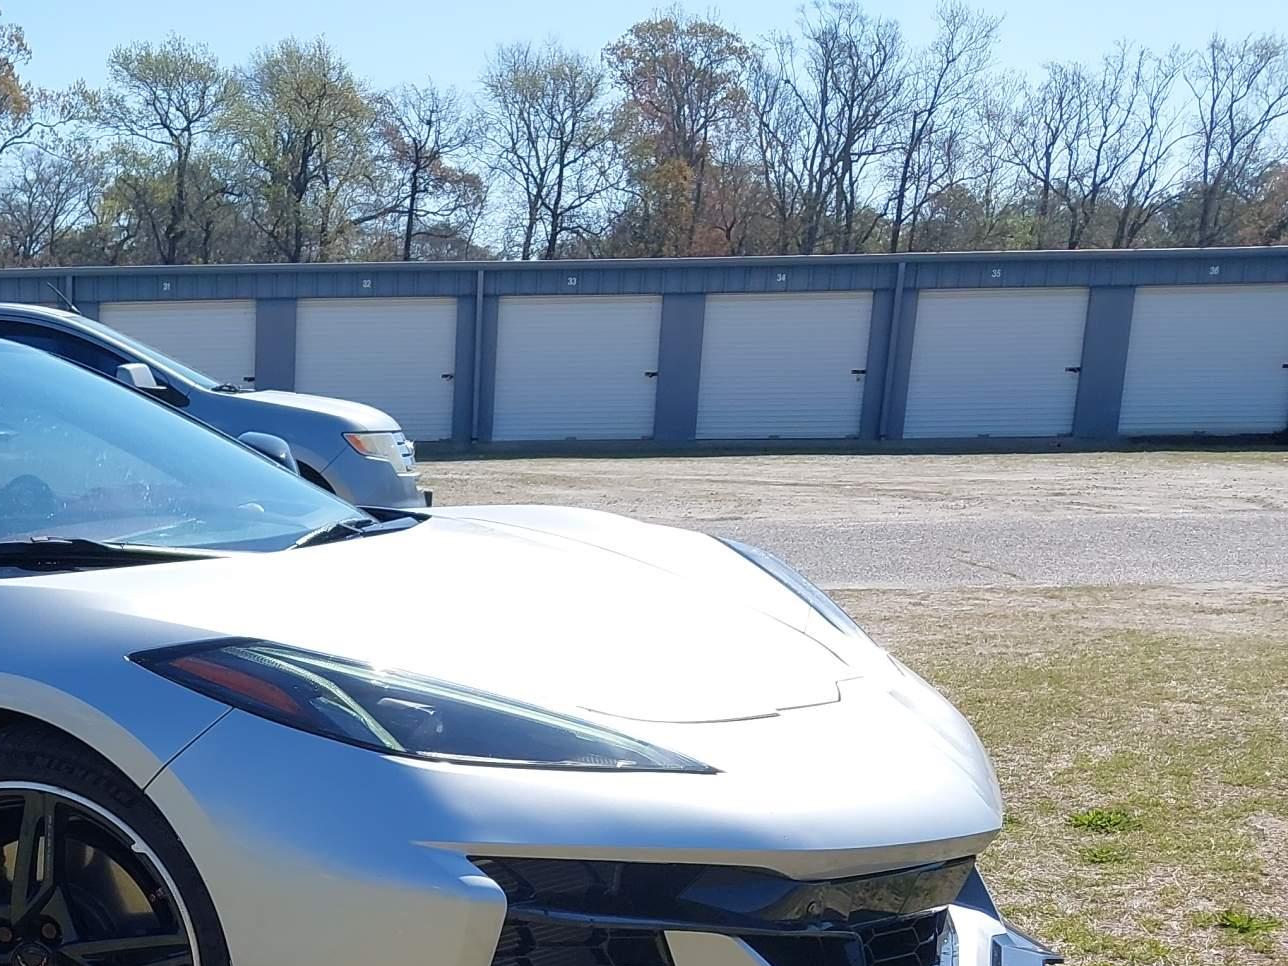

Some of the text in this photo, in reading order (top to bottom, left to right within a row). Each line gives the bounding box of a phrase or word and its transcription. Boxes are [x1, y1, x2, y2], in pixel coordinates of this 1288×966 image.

[992, 269, 1001, 278] 35
[1209, 266, 1219, 275] 36
[567, 277, 577, 286] 33
[777, 273, 786, 282] 34
[362, 279, 371, 288] 32
